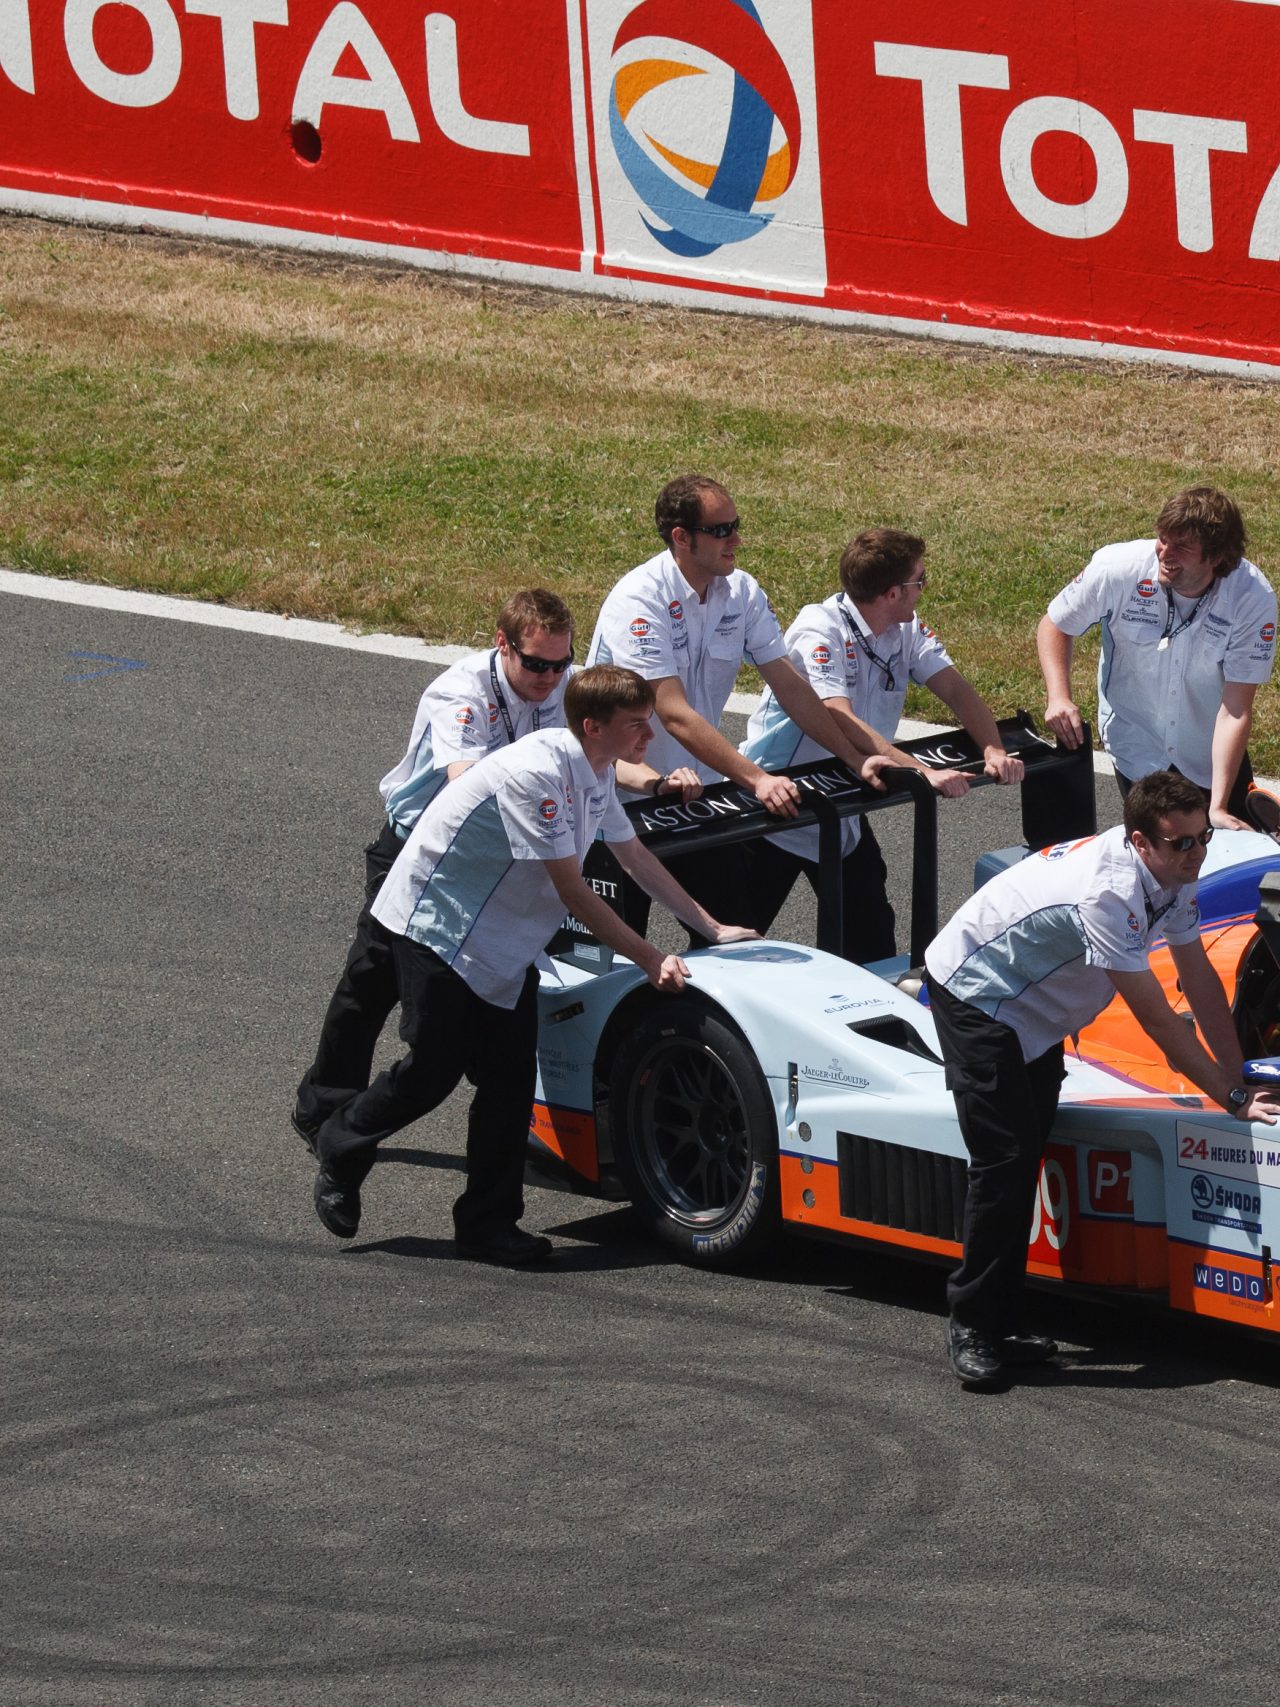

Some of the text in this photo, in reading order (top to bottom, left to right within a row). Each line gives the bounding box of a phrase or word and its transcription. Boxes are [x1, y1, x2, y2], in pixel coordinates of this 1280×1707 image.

[639, 794, 741, 831] ASTON
[823, 998, 883, 1014] EUROVIA
[1180, 1136, 1209, 1160] 24
[1211, 1146, 1247, 1164] HEURES
[1250, 1150, 1264, 1165] DU
[1216, 1185, 1261, 1215] ŠKODA
[697, 1193, 760, 1255] MICHELIN
